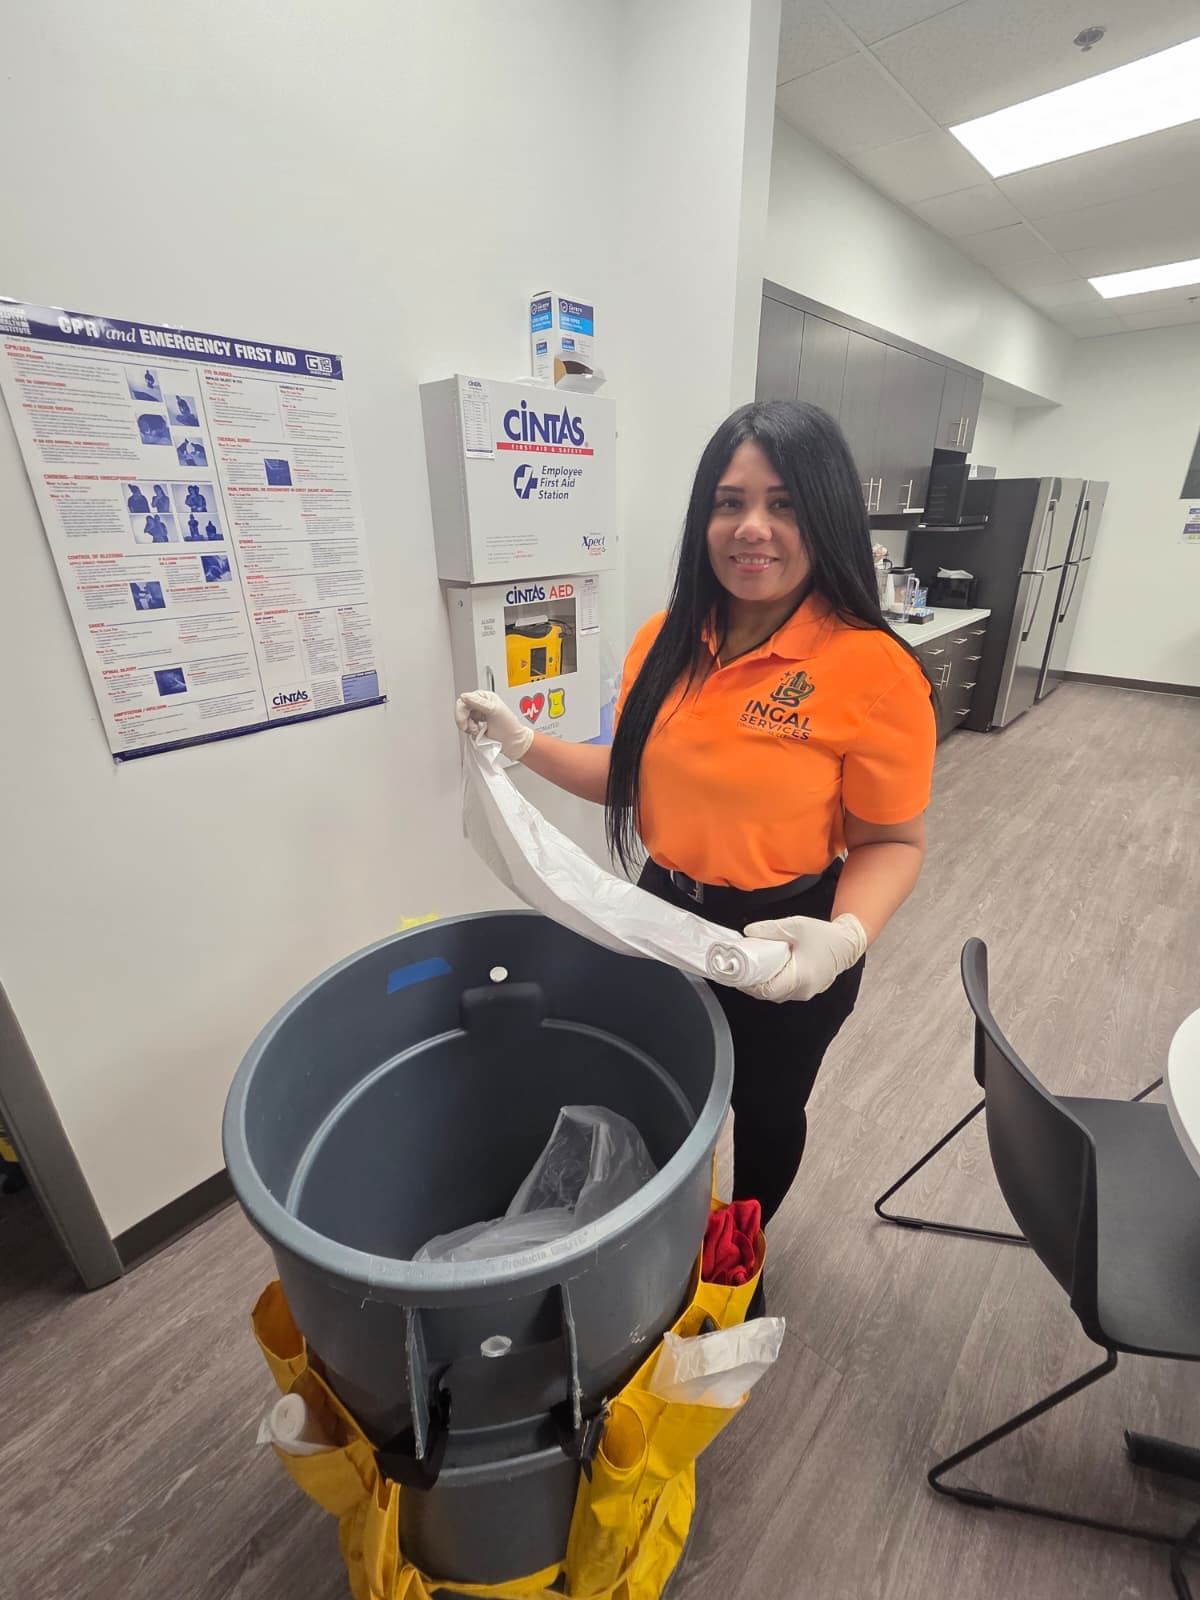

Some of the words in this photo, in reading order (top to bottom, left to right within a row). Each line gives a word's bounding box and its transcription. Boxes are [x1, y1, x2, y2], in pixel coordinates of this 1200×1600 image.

[57, 316, 100, 339] CPR
[105, 327, 136, 343] and
[139, 328, 231, 356] EMERGENCY
[234, 343, 272, 365] FIRST
[275, 350, 297, 367] AID
[503, 400, 585, 447] CINTAS
[511, 443, 532, 451] FIRST
[540, 477, 559, 488] First
[561, 477, 576, 488] Aid
[541, 465, 583, 482] Employee
[538, 489, 569, 501] Station
[506, 584, 546, 605] CINTAS
[549, 583, 574, 600] AED
[272, 689, 308, 706] CINTAS
[745, 700, 812, 732] INGAL
[740, 713, 810, 740] SERVICES
